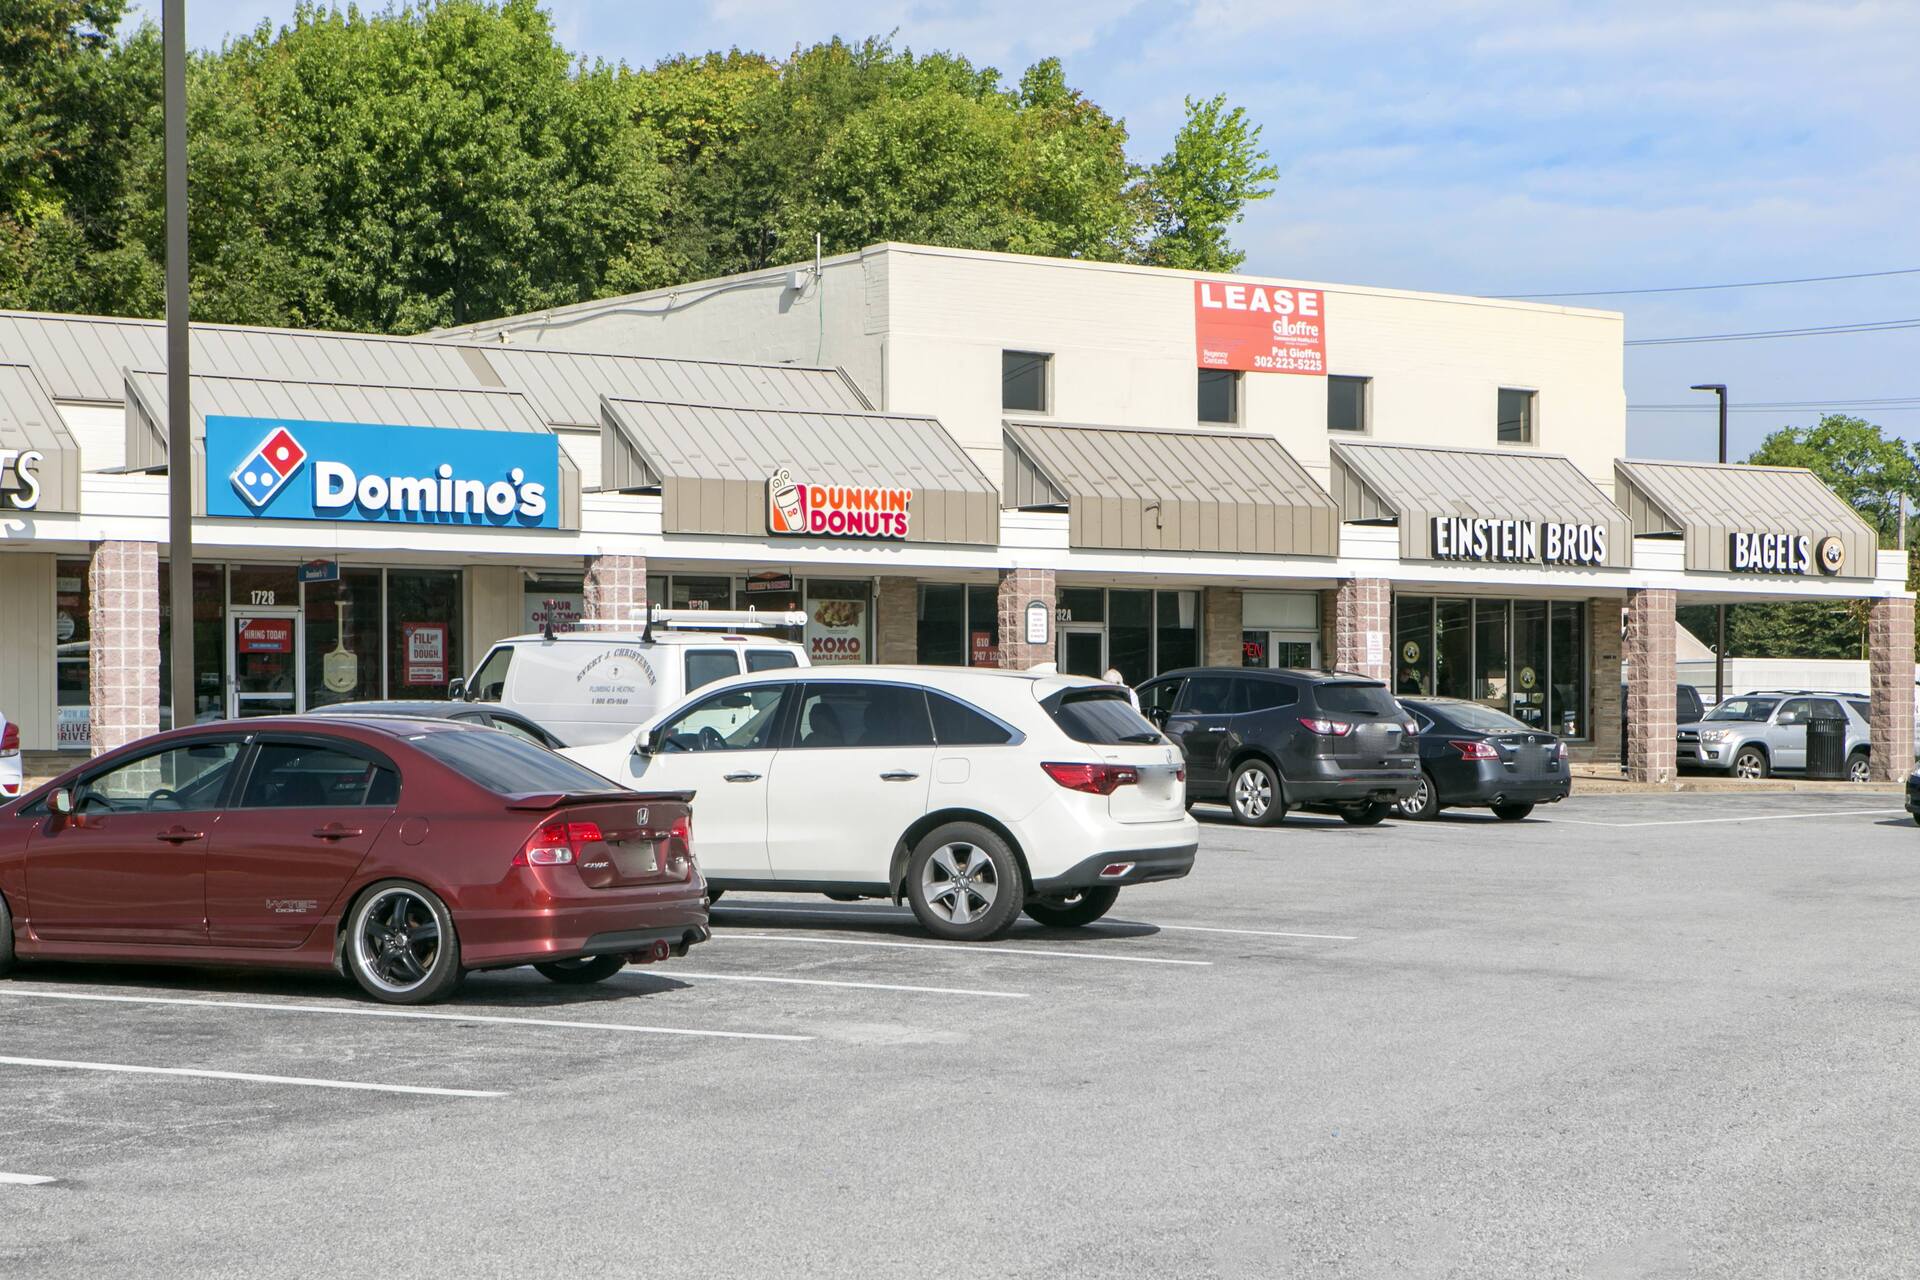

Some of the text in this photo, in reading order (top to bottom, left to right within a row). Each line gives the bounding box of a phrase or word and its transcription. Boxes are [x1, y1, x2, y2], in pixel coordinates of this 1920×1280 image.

[1200, 283, 1319, 316] LEASE
[1271, 346, 1287, 357] Pat
[315, 461, 546, 517] Domino's
[811, 511, 908, 535] DONUTS
[1436, 517, 1607, 563] EINSTEIN BROS
[1735, 532, 1810, 571] BAGELS
[251, 590, 275, 605] 1728
[543, 600, 571, 610] YOUR
[532, 612, 582, 622] ON-TWO
[539, 623, 576, 632] PNCH
[244, 630, 266, 640] HIRING
[414, 633, 433, 645] FILL
[812, 637, 861, 653] XOXO
[977, 638, 989, 648] 610
